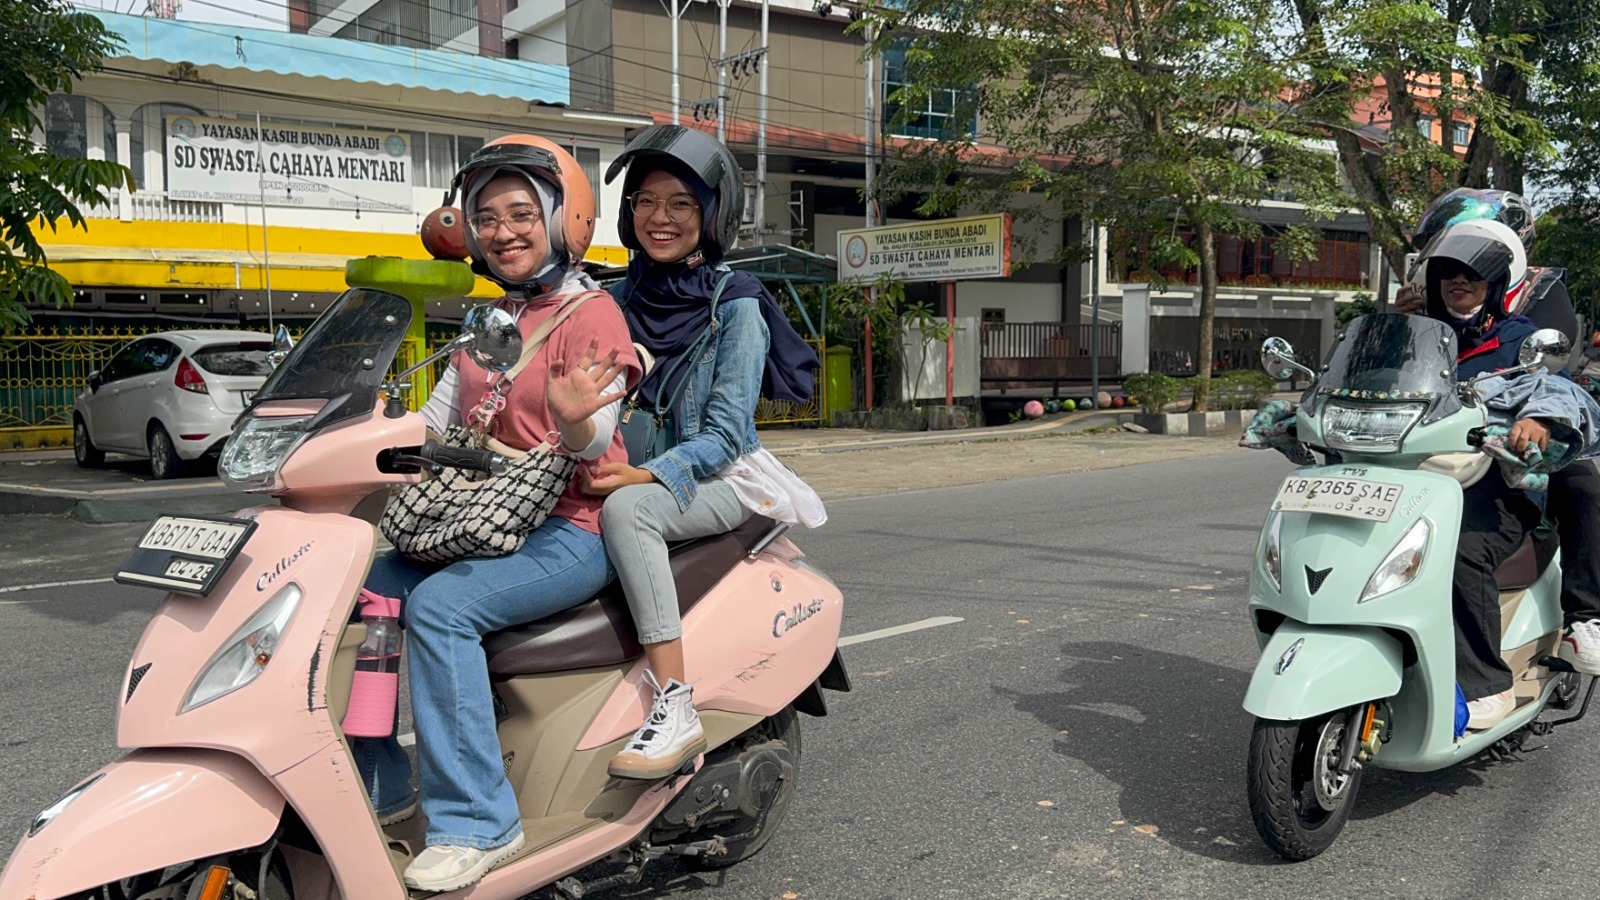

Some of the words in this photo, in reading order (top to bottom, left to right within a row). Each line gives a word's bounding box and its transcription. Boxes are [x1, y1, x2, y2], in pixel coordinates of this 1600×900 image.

[202, 123, 259, 141] YAYASAN
[261, 128, 299, 144] KASIH
[301, 131, 342, 148] BUNDA
[344, 135, 380, 150] ABADI
[174, 144, 196, 169] SD
[199, 146, 267, 174] SWASTA
[269, 151, 335, 178] CAHAYA
[337, 155, 406, 183] MENTARI
[875, 231, 908, 246] YAYASAN
[909, 229, 932, 242] KASIH
[934, 227, 960, 240] BUNDA
[962, 224, 987, 237] ABADI
[869, 254, 880, 265] SD
[882, 251, 915, 265] SWASTA
[917, 249, 951, 262] CAHAYA
[953, 244, 995, 259] MENTARI
[1342, 467, 1368, 477] TVS
[1284, 479, 1308, 494] KB
[1309, 480, 1357, 497] 2365
[1358, 484, 1398, 502] SAE
[256, 540, 315, 592] Callisto
[772, 598, 824, 638] Callisto
